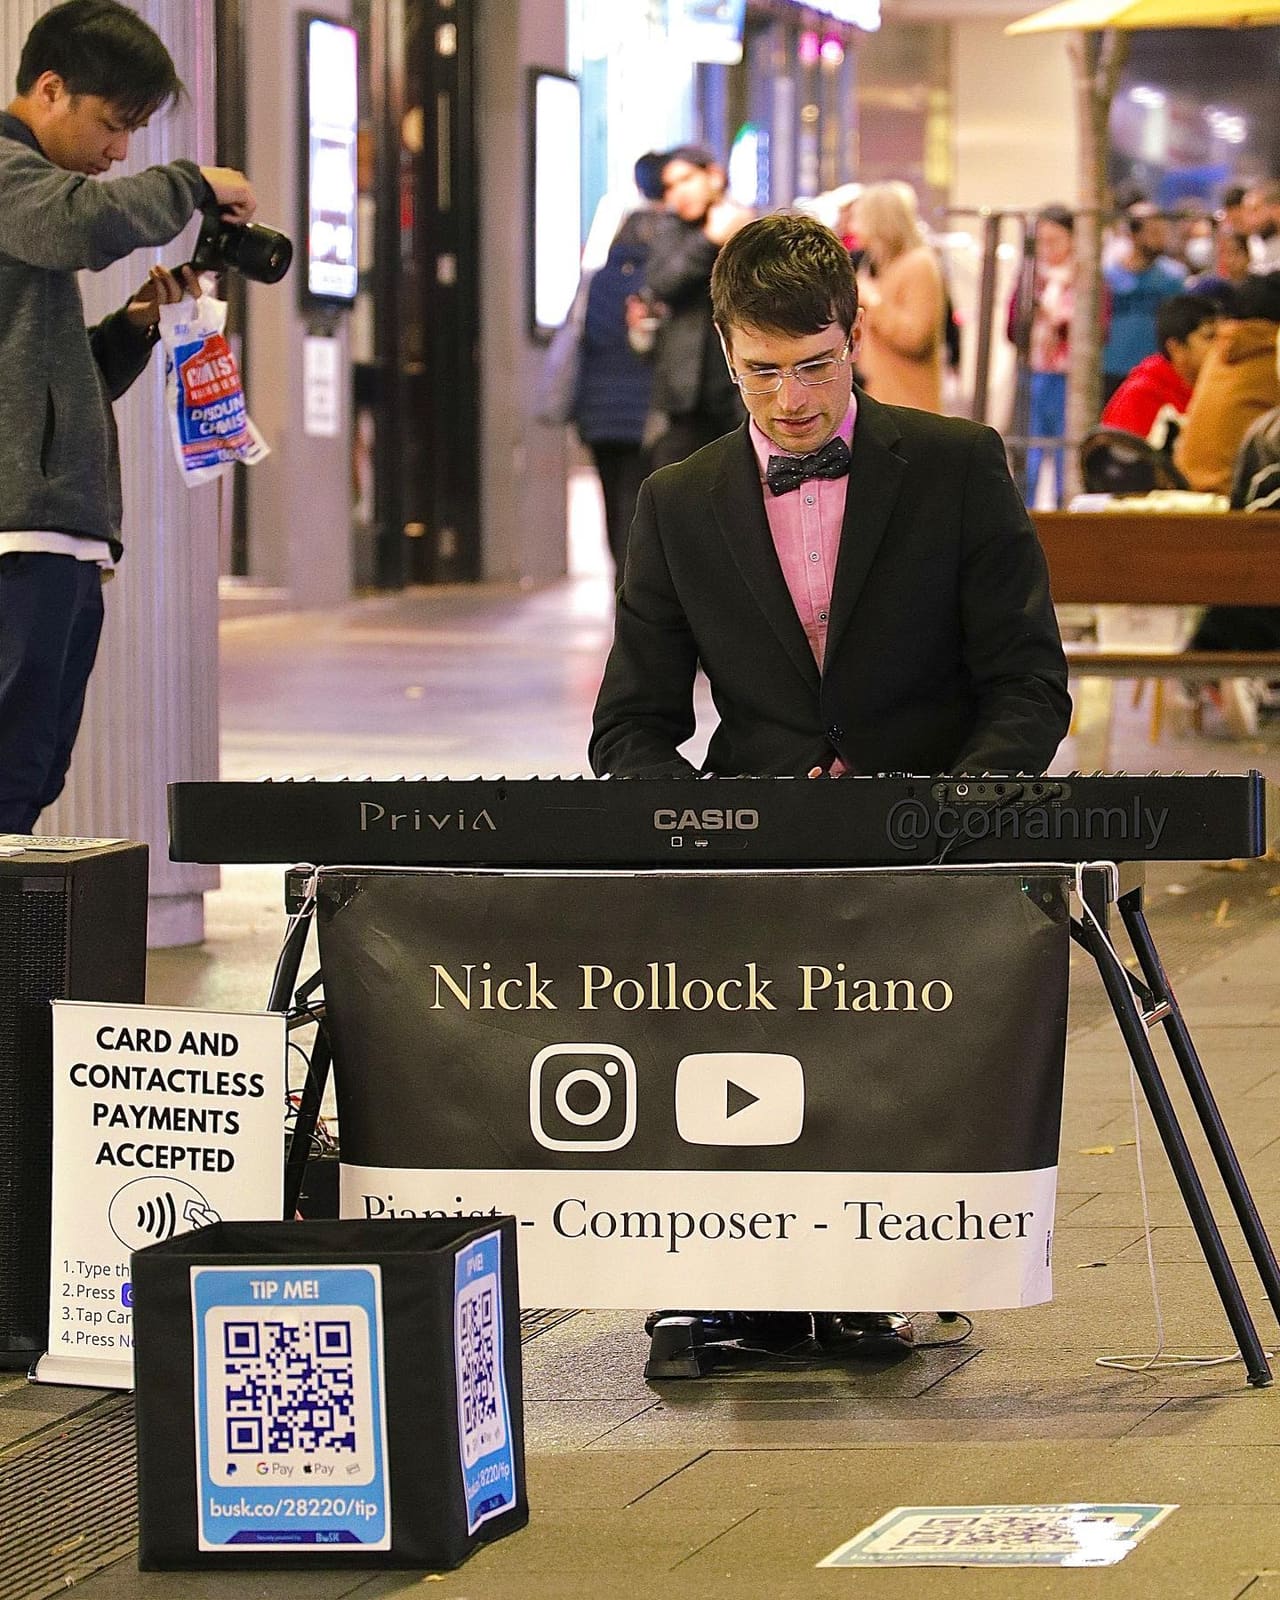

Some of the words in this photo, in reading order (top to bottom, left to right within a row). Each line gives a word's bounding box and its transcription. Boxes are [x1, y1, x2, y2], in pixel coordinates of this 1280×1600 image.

[653, 808, 759, 830] CASIO
[430, 963, 557, 1011] Nick
[579, 963, 778, 1012] Pollock
[798, 964, 953, 1013] Piano
[96, 1026, 172, 1053] CARD
[179, 1031, 239, 1057] AND
[70, 1062, 265, 1098] CONTACTLESS
[93, 1102, 240, 1135] PAYMENTS
[95, 1141, 235, 1173] ACCEPTED
[552, 1199, 797, 1254] Composer
[843, 1199, 1034, 1242] Teacher
[250, 1280, 279, 1300] TIP
[283, 1280, 320, 1300] ME!
[271, 1463, 294, 1477] Pay
[314, 1463, 335, 1477] Pay
[209, 1497, 378, 1521] busk.co/28220/tip
